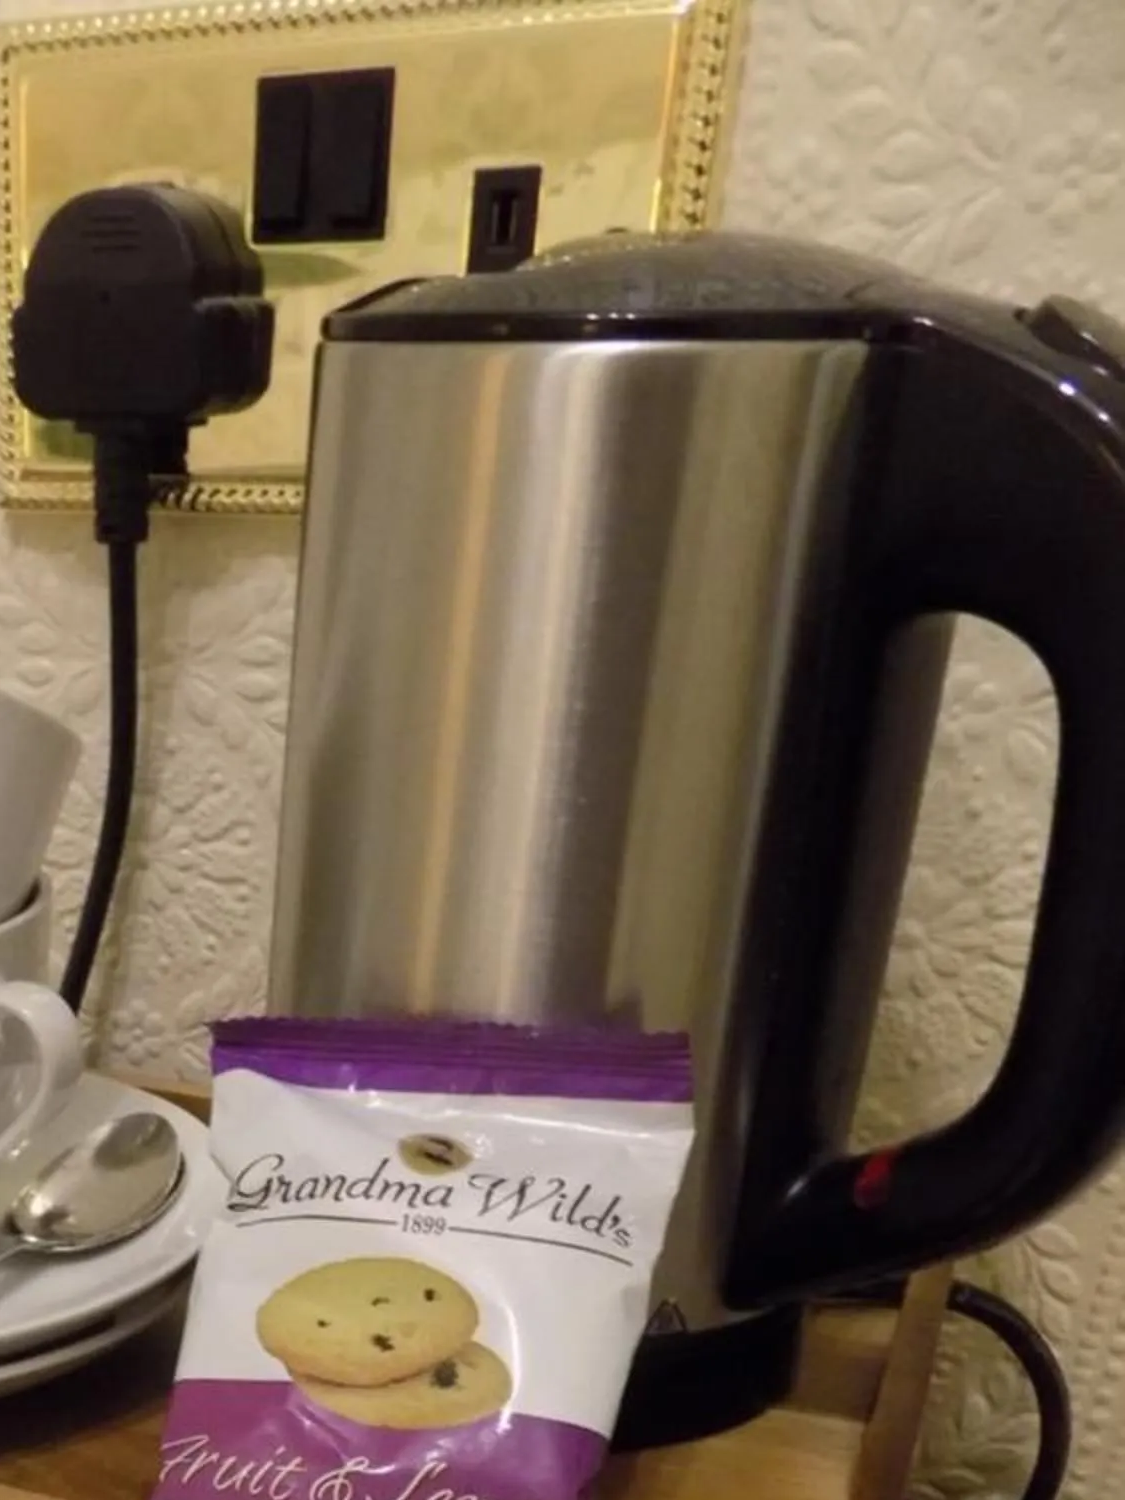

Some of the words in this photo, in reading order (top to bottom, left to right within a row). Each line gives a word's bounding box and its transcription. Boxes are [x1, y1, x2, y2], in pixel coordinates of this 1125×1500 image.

[228, 1153, 454, 1212] Grandma
[467, 1173, 634, 1248] Wild's
[401, 1213, 447, 1236] 1899
